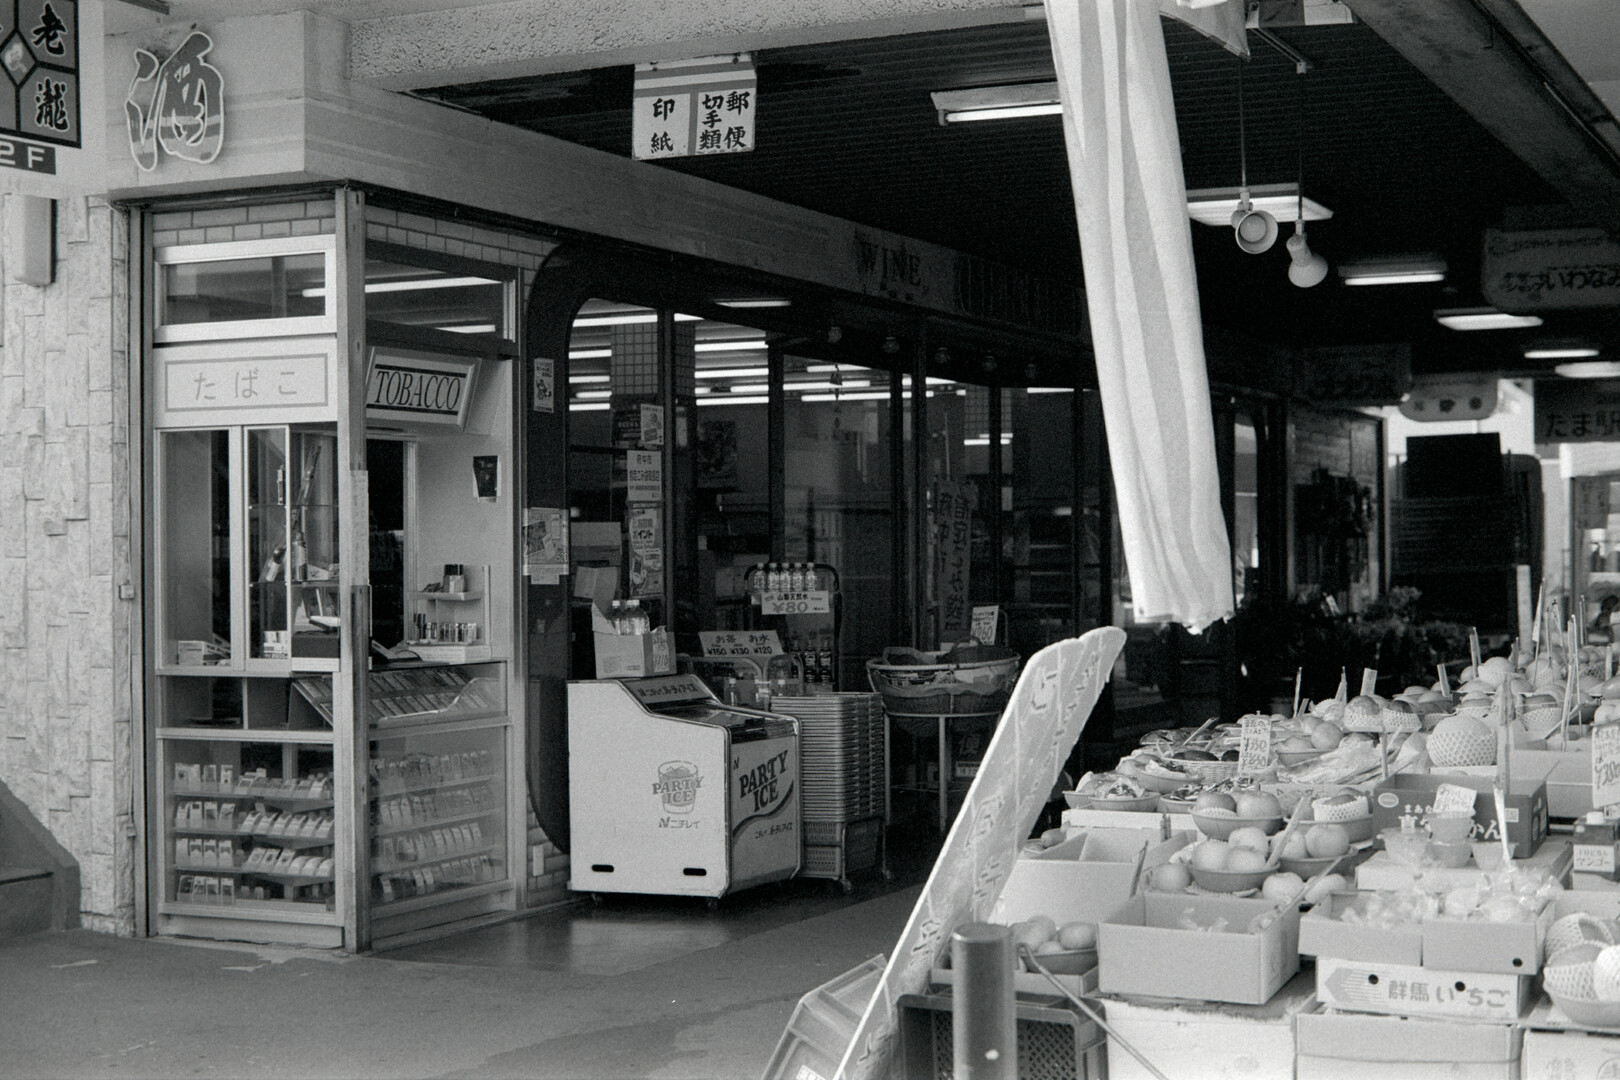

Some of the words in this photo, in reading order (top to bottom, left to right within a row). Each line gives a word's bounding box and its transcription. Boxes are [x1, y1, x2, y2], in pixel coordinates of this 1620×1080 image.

[125, 31, 225, 172] 酒
[650, 98, 676, 154] 印紙
[699, 94, 725, 150] 切手類
[724, 90, 751, 149] 郵便
[193, 367, 299, 401] たばこ
[374, 370, 462, 411] TOBACCO
[772, 601, 809, 613] ¥80
[730, 647, 750, 655] ¥130
[753, 645, 773, 655] ¥120
[652, 776, 705, 795] PARTY
[739, 749, 788, 798] PARTY
[666, 790, 694, 804] ICE
[753, 779, 779, 812] ICE
[1388, 979, 1511, 1008] 群馬いちご
